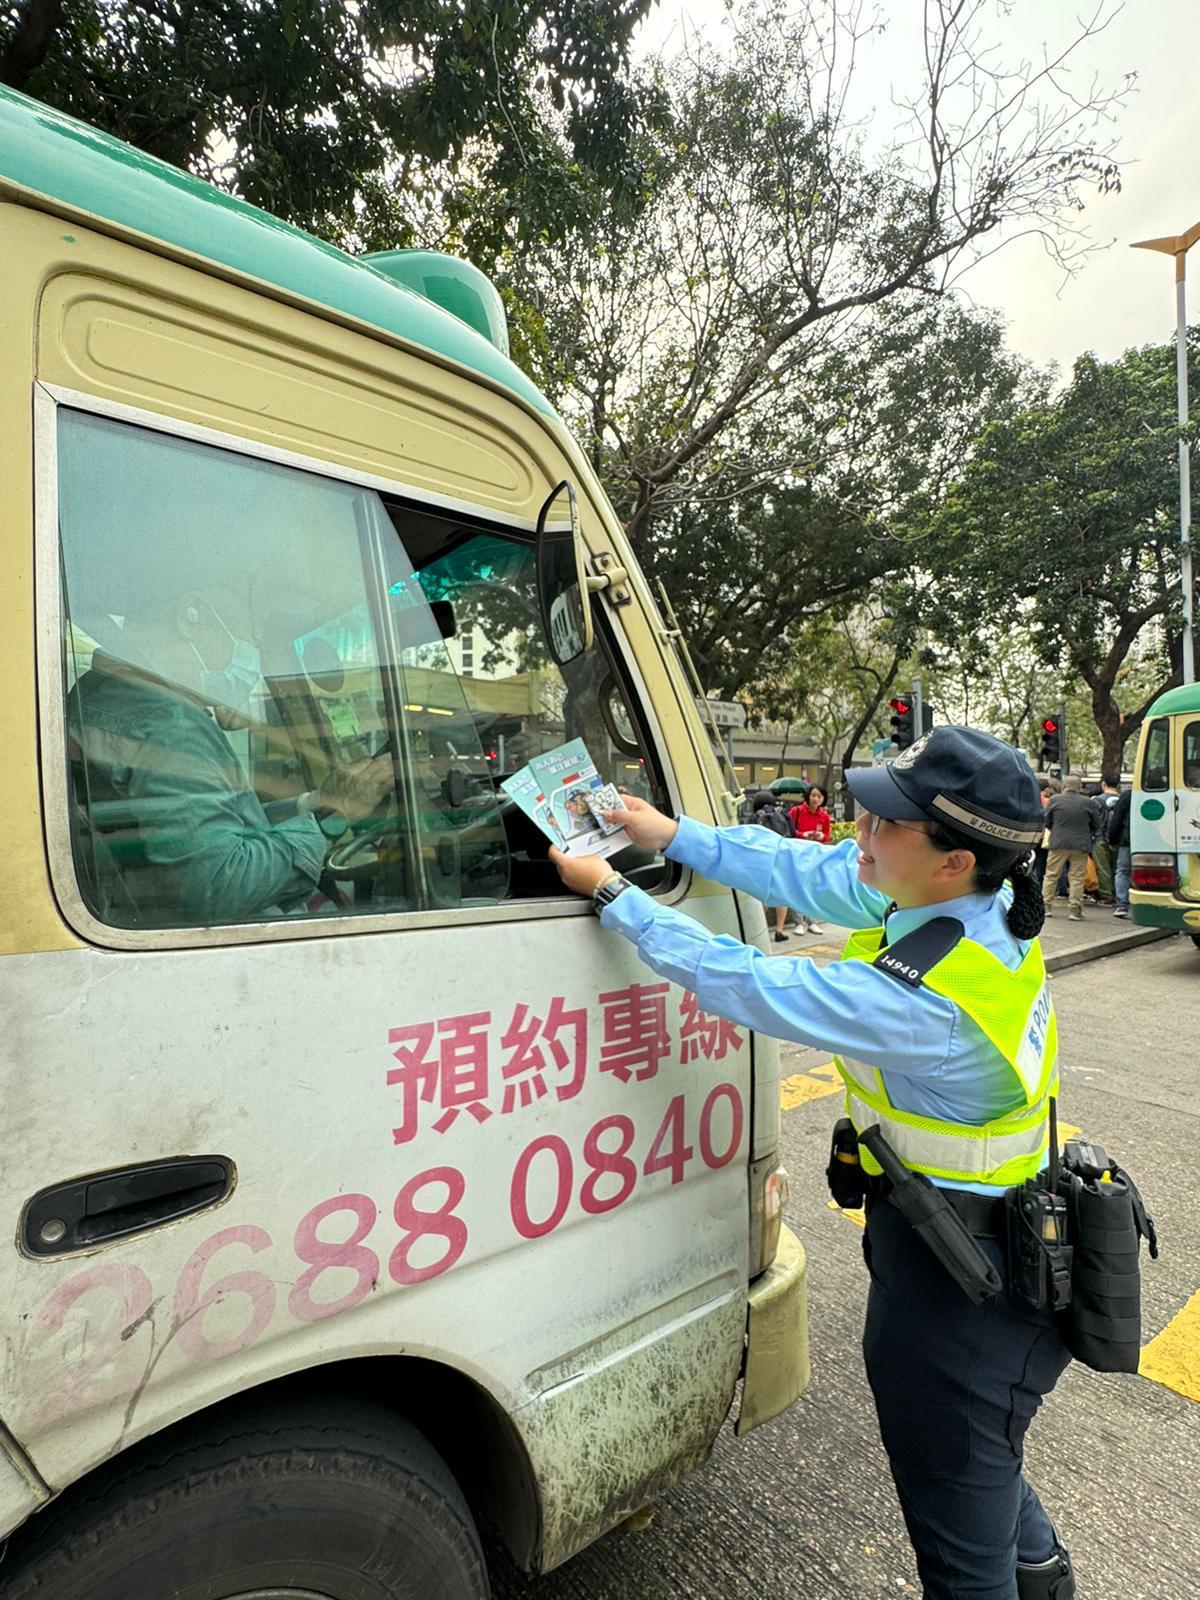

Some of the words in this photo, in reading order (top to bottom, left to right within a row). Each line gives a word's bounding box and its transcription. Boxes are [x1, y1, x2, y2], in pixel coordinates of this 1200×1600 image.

[979, 820, 1014, 839] POLICE
[880, 954, 919, 979] 14940
[31, 1166, 469, 1430] 2688
[510, 1082, 745, 1239] 0840
